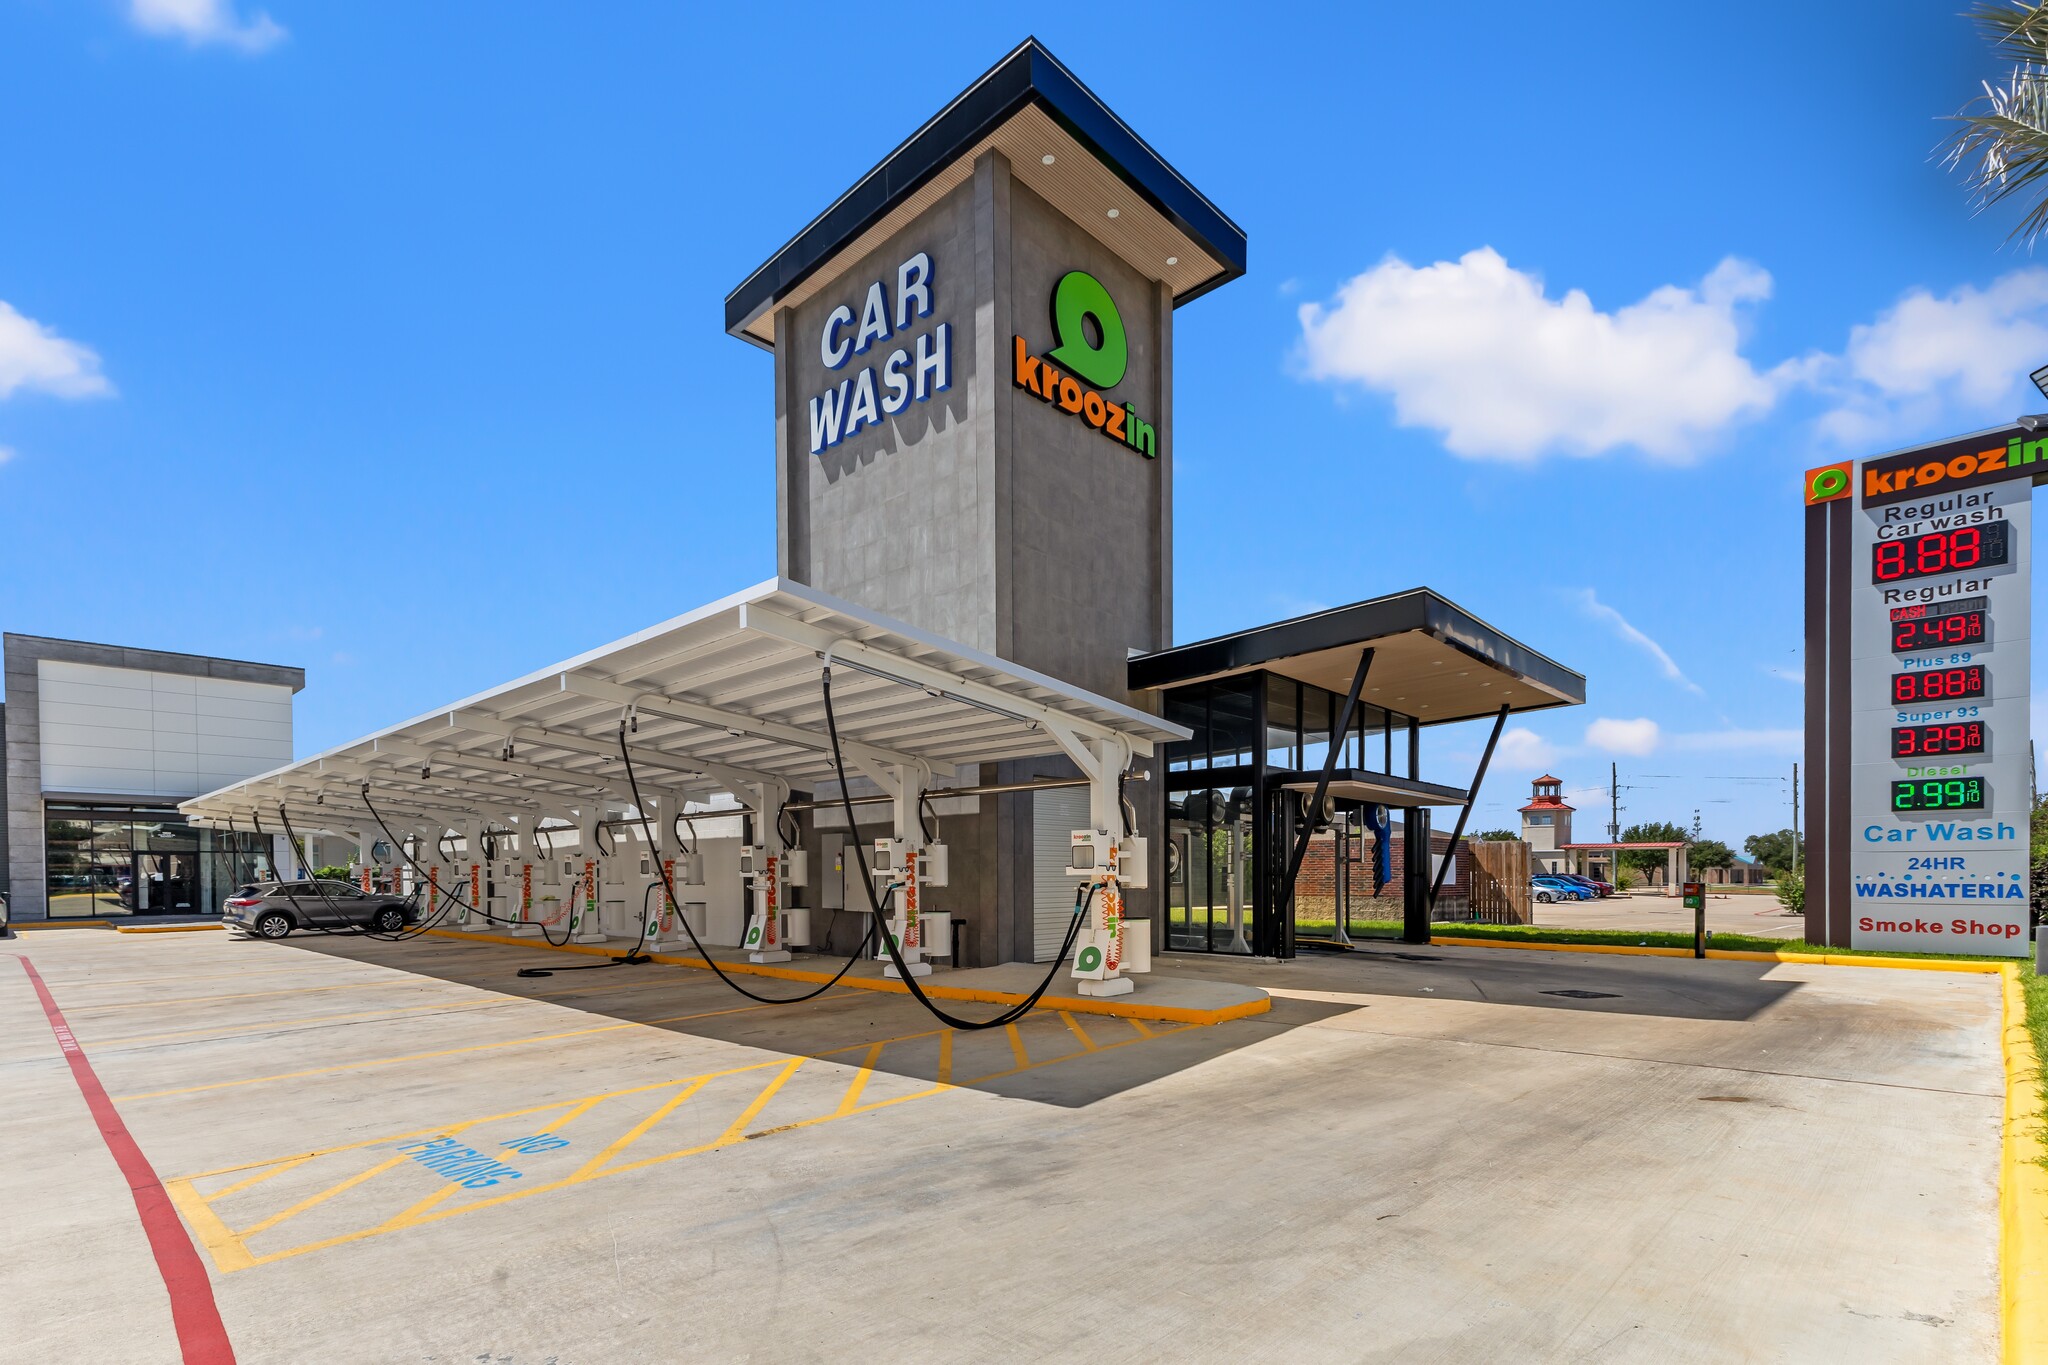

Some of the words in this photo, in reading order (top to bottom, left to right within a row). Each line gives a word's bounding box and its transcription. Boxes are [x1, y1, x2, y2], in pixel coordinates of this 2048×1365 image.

[821, 252, 935, 370] CAR
[810, 322, 951, 455] WASH
[1012, 335, 1155, 459] kroozin
[1866, 436, 2048, 497] kroozin
[1884, 491, 1994, 523] Regular
[1877, 521, 1923, 540] Car
[1930, 505, 2003, 531] wash
[1877, 527, 1980, 580] 8.88
[1884, 577, 1994, 605] Regular
[1890, 604, 1927, 621] CASH
[1896, 615, 1966, 649] 2.49
[1903, 657, 1945, 669] Plus
[1950, 652, 1972, 665] 89
[1896, 669, 1966, 700] 8.88
[1896, 710, 1953, 723] Super
[1957, 705, 1980, 718] 93
[1897, 725, 1966, 755] 3.29
[1907, 764, 1968, 778] Diesel
[1895, 781, 1965, 808] 2.99
[1863, 825, 1918, 843] Car
[1925, 822, 2016, 842] Wash
[1908, 857, 1967, 871] 24HR
[585, 862, 596, 912] kroozin
[1855, 883, 2025, 899] WASHATERIA
[1858, 917, 1944, 935] Smoke
[1951, 919, 2022, 939] Shop
[499, 1133, 571, 1155] NO
[397, 1137, 524, 1189] PARKING
